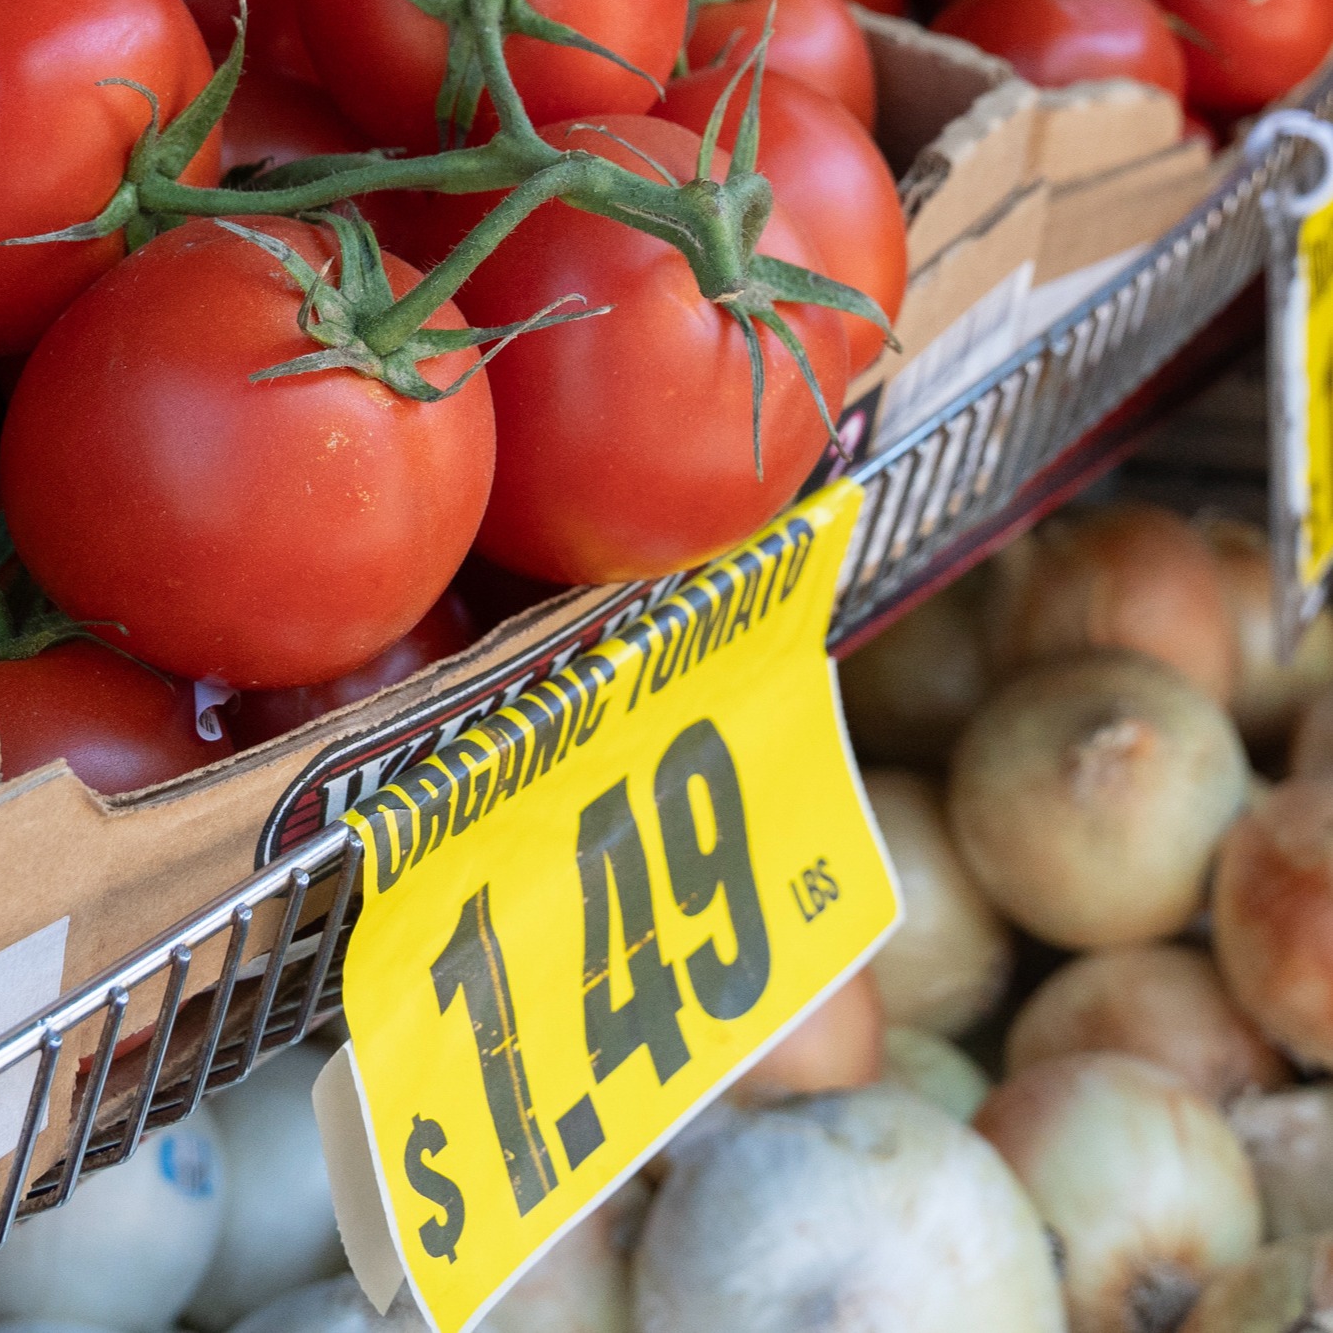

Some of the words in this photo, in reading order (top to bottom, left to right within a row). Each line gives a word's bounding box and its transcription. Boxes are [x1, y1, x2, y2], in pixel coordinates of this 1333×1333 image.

[351, 658, 617, 894] ORGANIC
[625, 519, 815, 712] TOMATO
[429, 717, 772, 1218] 1.49
[787, 858, 842, 924] LBS
[403, 1111, 466, 1265] $
